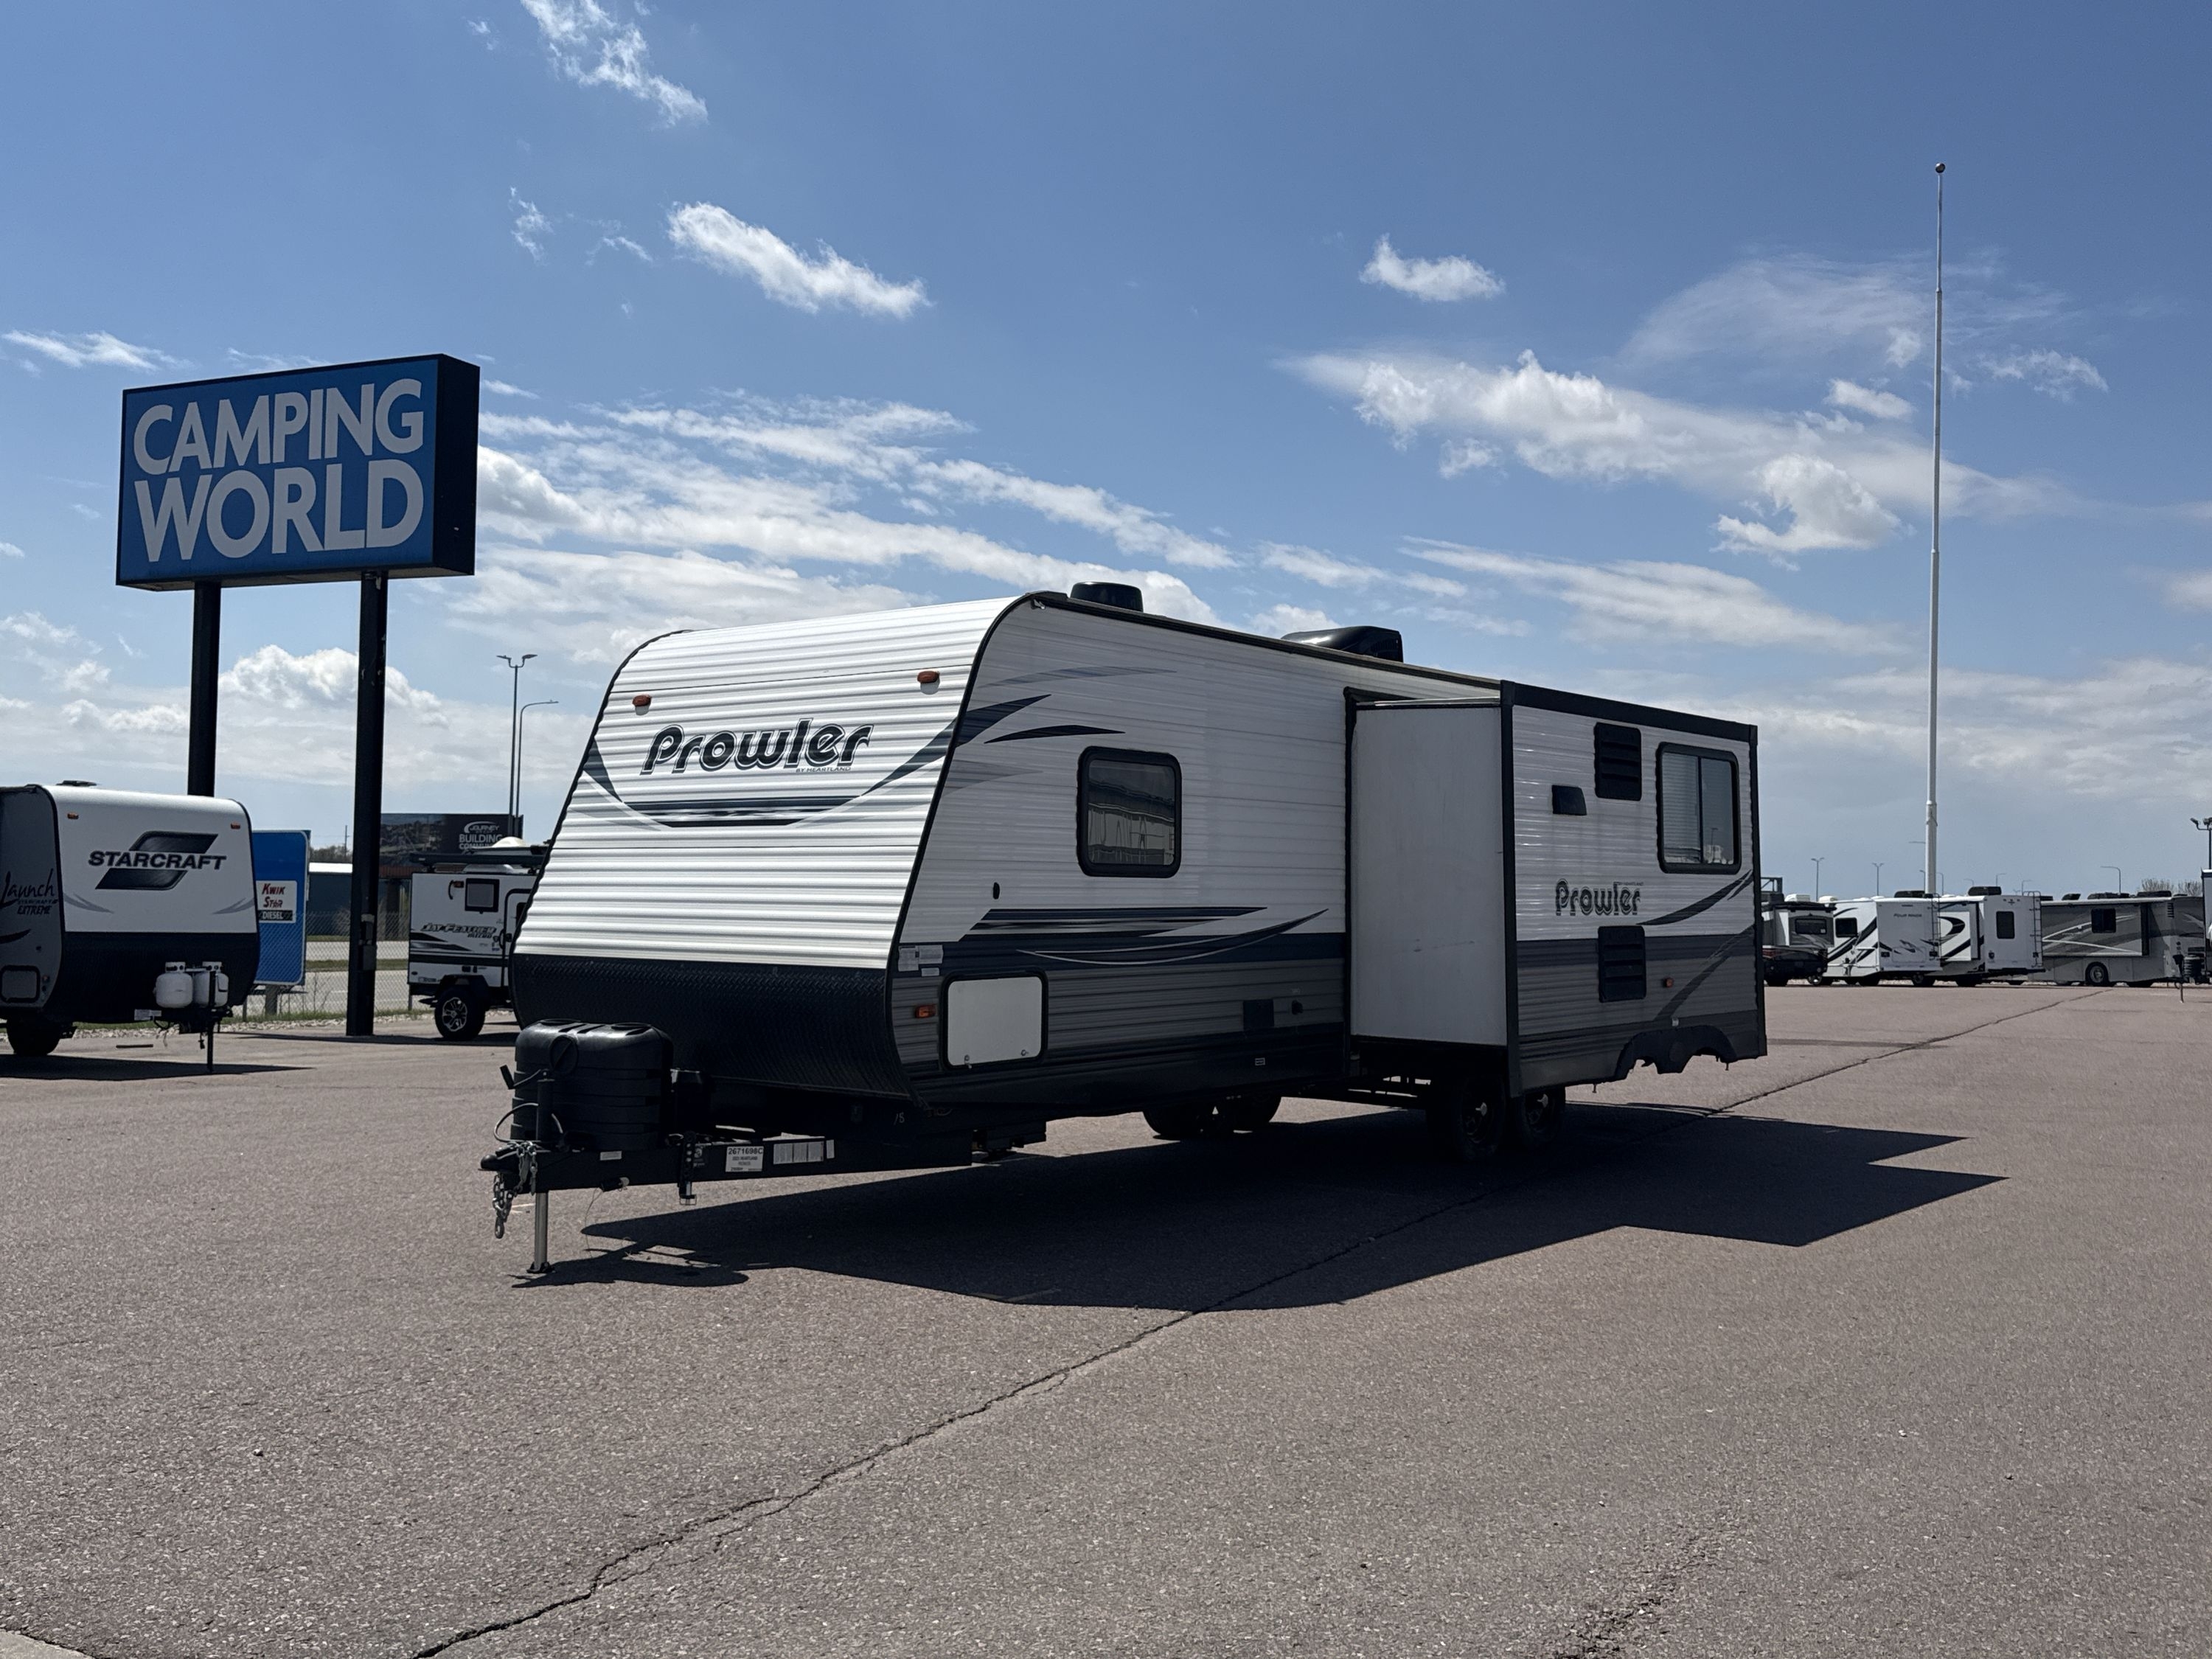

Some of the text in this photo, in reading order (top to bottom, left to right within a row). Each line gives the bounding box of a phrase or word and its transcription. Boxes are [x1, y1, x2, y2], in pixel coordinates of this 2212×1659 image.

[133, 378, 424, 475] CAMPING
[134, 459, 424, 563] WORLD
[640, 717, 874, 775] Prowler
[459, 834, 503, 843] BUILDING
[88, 851, 226, 870] STARCRAFT
[0, 868, 55, 909] Launch
[262, 883, 286, 895] KWIK
[1555, 877, 1641, 916] Prowler
[262, 911, 284, 920] DIESEL
